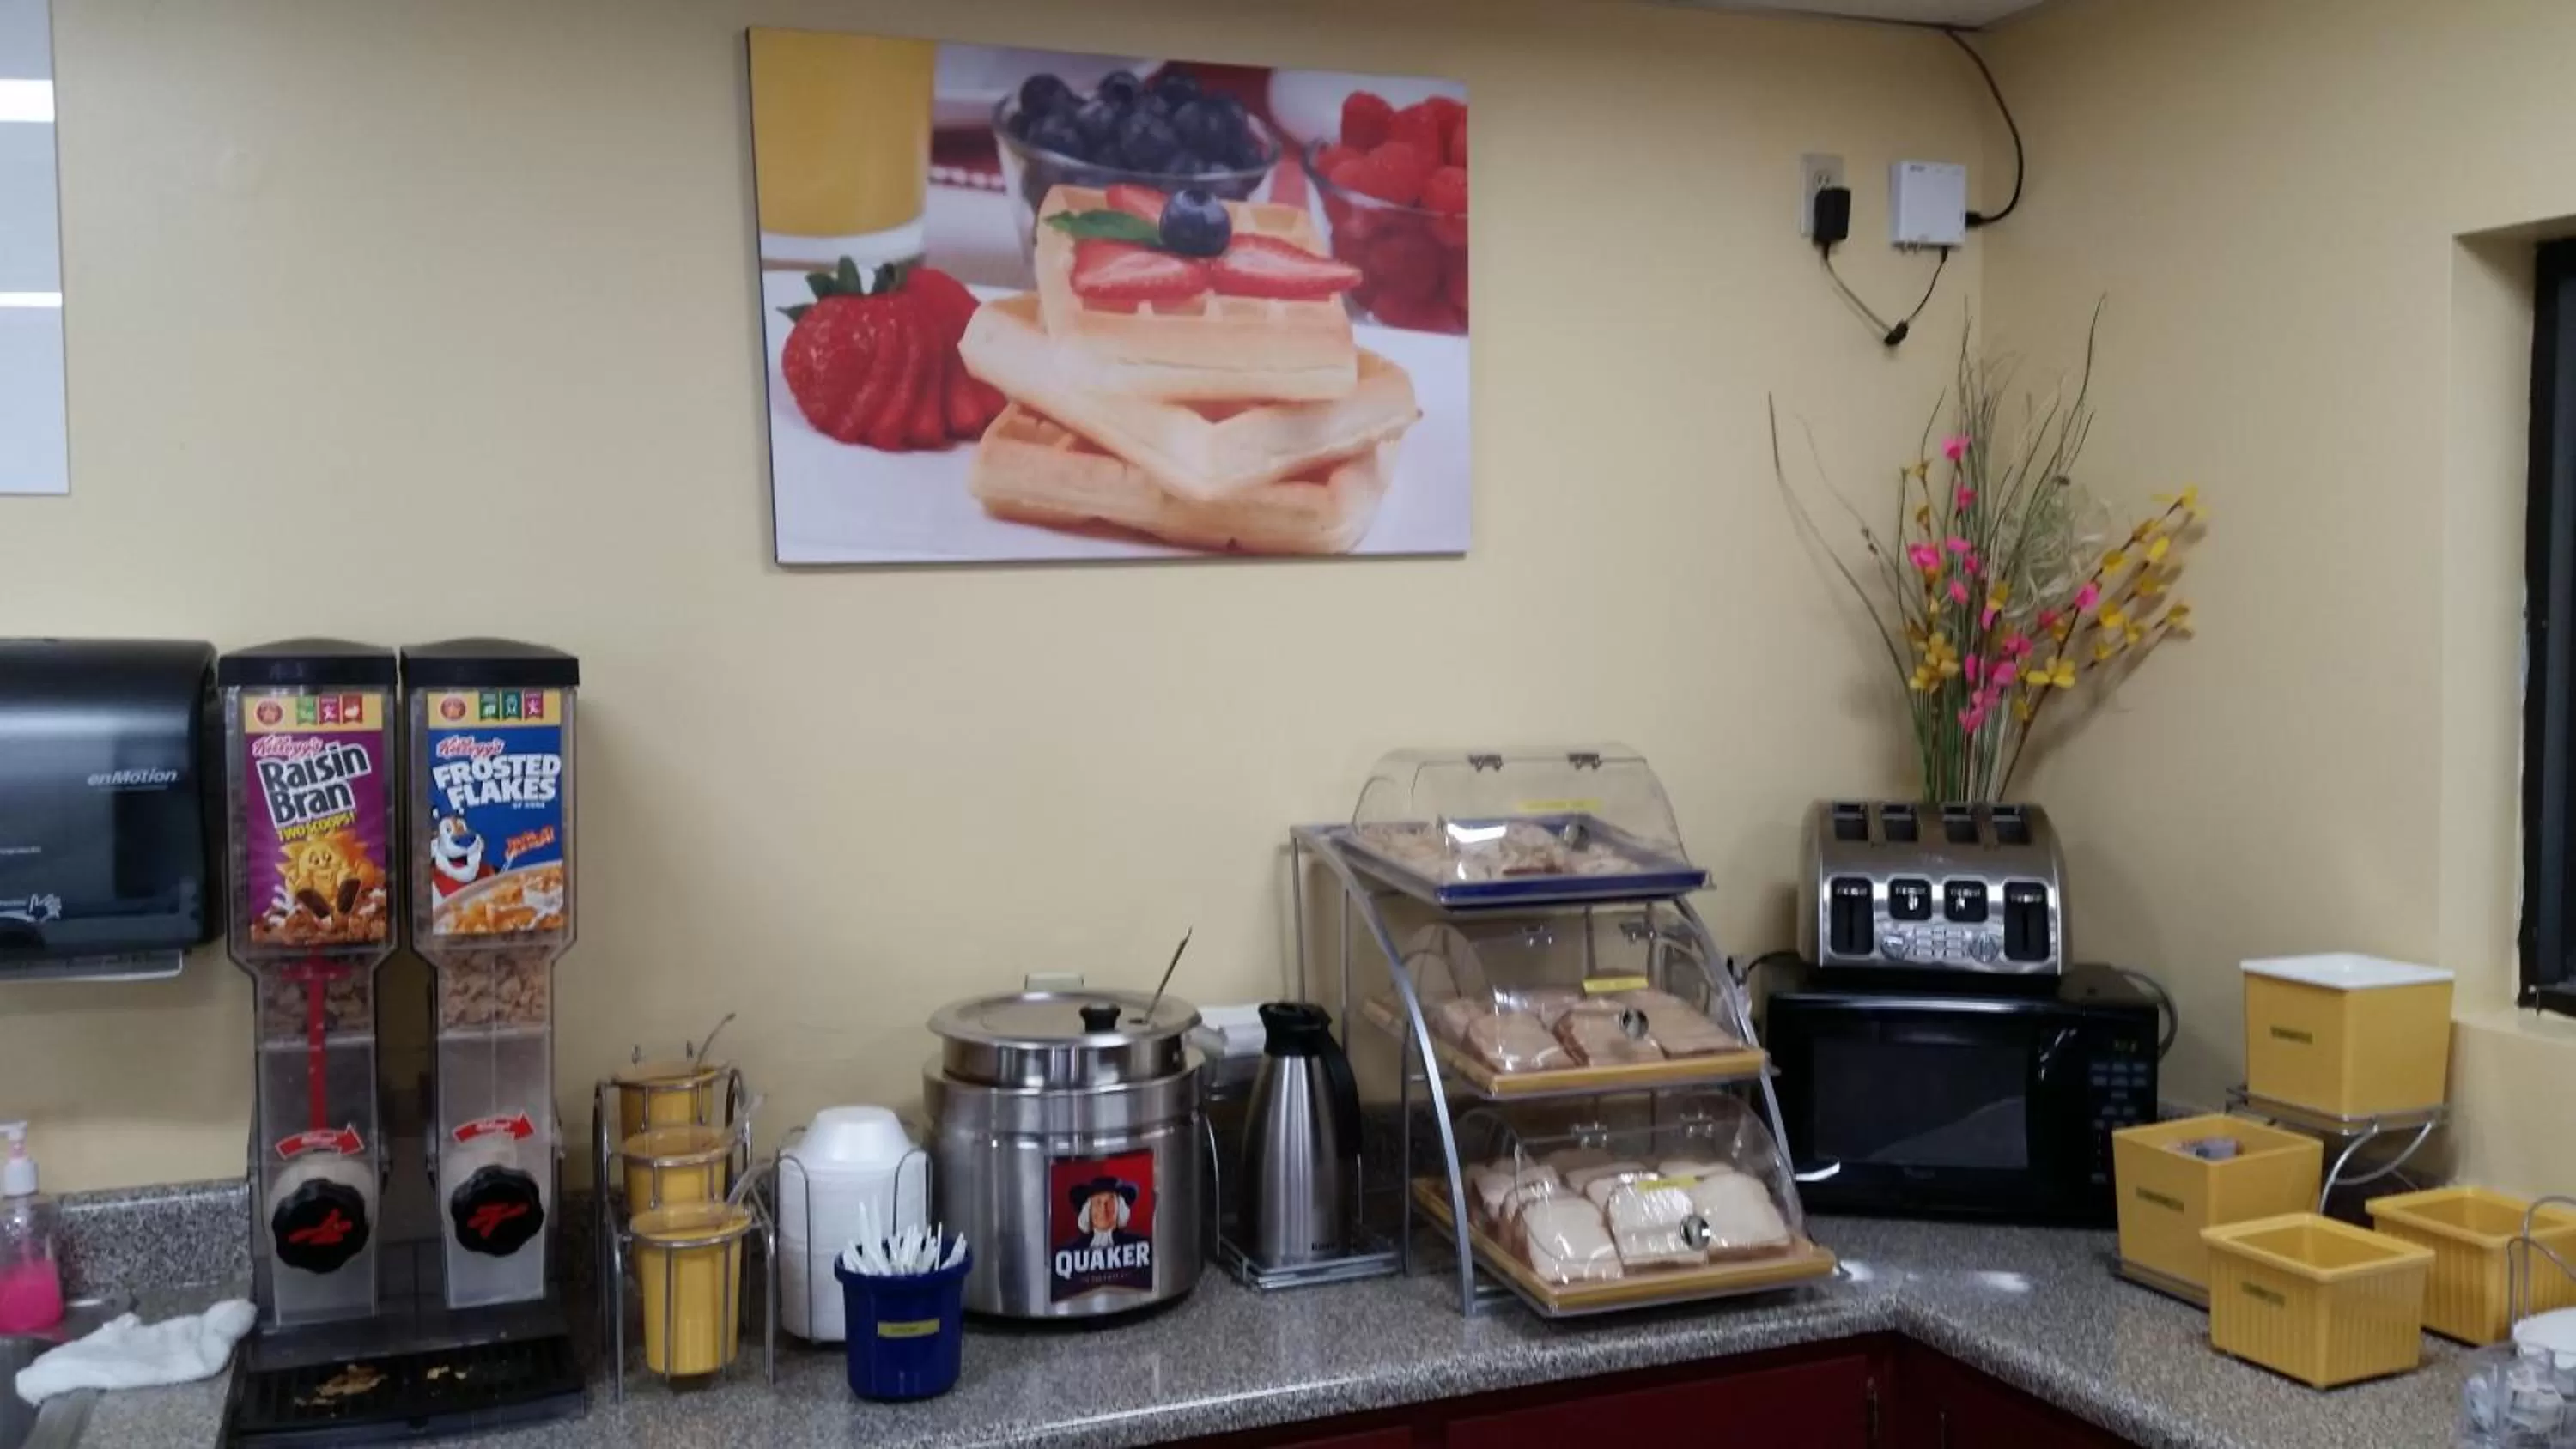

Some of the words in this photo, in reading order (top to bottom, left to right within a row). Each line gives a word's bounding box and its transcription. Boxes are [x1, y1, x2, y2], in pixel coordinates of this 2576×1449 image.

[87, 767, 178, 786] enMotion
[258, 743, 370, 791] Raisin
[433, 754, 562, 790] FROSTED
[269, 782, 355, 825] Bran
[447, 779, 556, 810] FLAKES
[1055, 1241, 1150, 1279] QUAKER
